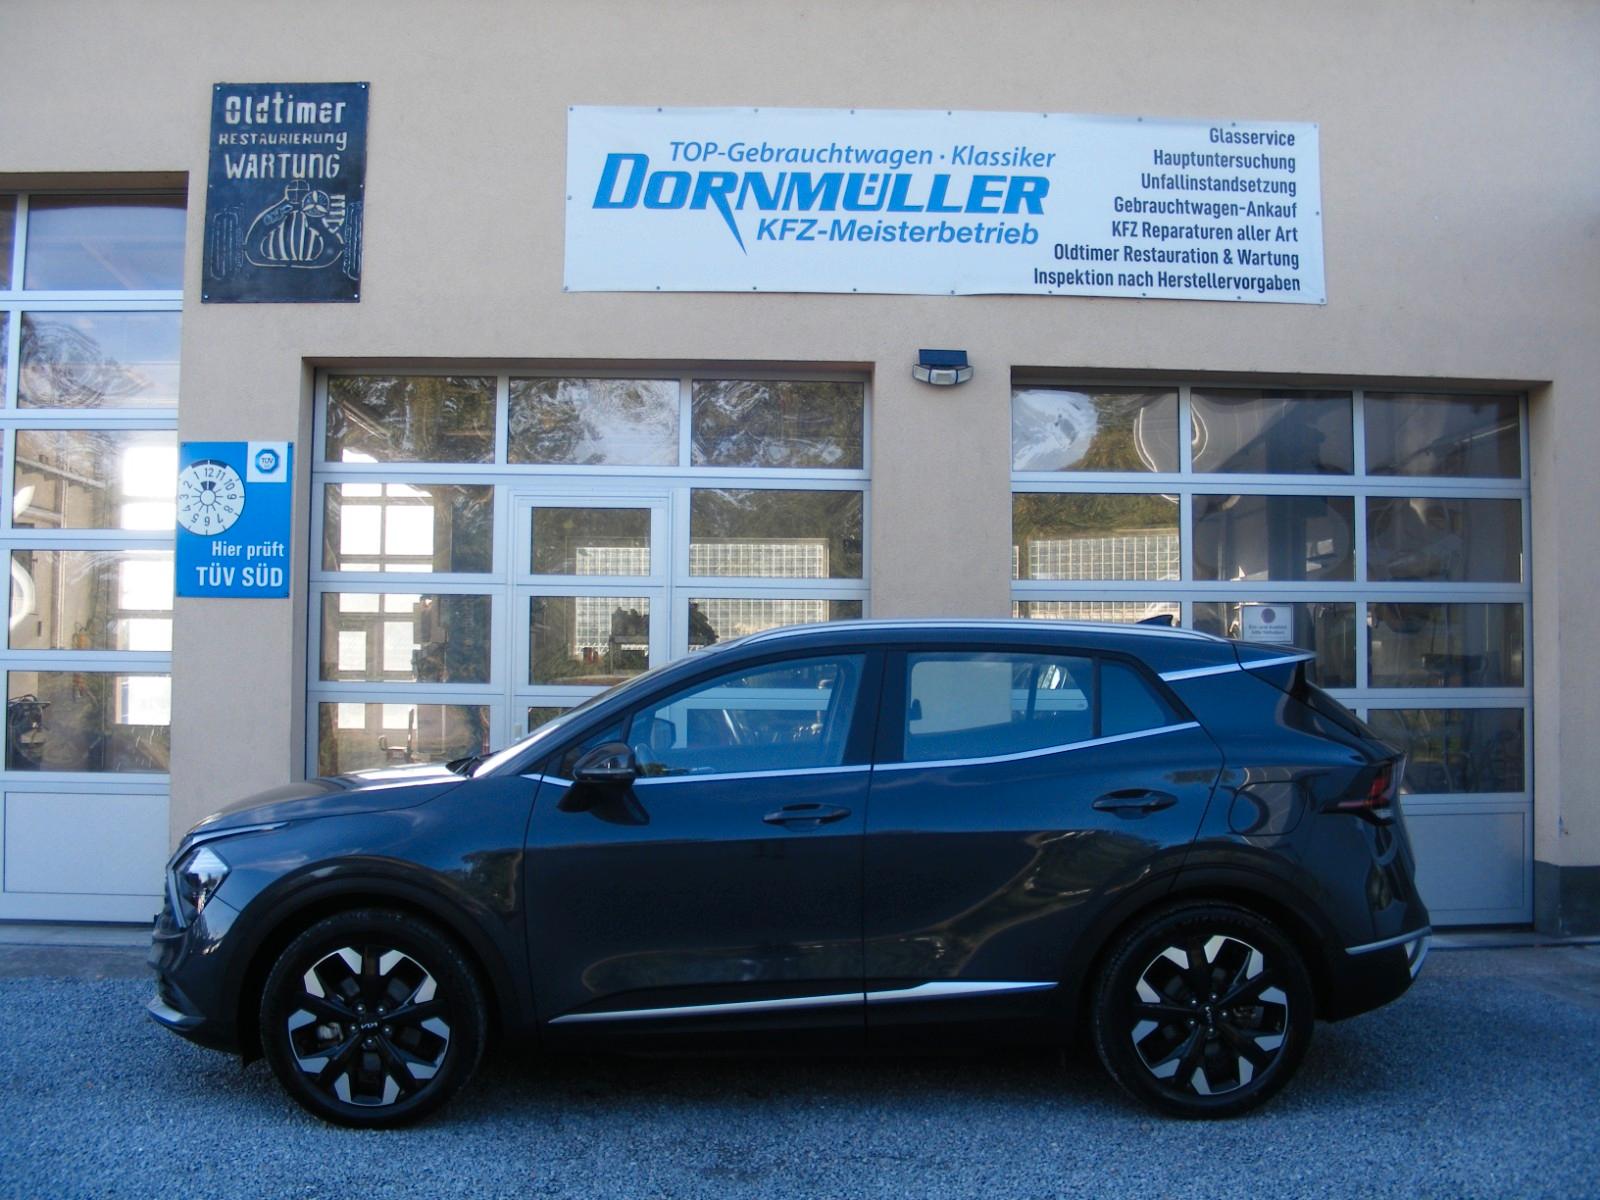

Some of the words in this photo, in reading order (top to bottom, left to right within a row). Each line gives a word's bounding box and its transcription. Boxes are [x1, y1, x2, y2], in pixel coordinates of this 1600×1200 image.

[225, 92, 346, 124] Oldtimer
[1210, 127, 1295, 146] Glasservice
[670, 141, 933, 169] TOP-Gebrauchtwagen
[951, 145, 1056, 168] Klassiker
[1154, 149, 1296, 173] Hauptuntersuchung
[1141, 173, 1296, 197] Unfallinstandsetzung
[1114, 196, 1298, 219] Gebrauchtwagen-Ankauf
[756, 218, 1039, 244] KFZ-Meisterbetrieb
[1112, 220, 1138, 238] KFZ
[1142, 221, 1233, 242] Reparaturen
[1237, 225, 1271, 242] aller
[1275, 225, 1299, 243] Art
[1054, 243, 1120, 261] Oldtimer
[1123, 245, 1219, 265] Restauration
[1223, 248, 1233, 265] &
[1238, 249, 1300, 270] Wartung
[1034, 267, 1114, 288] Inspektion
[1118, 270, 1154, 288] nach
[1158, 271, 1301, 294] Herstellervorgaben
[204, 467, 214, 478] 12
[211, 540, 243, 557] Hier
[246, 541, 285, 561] prüft
[195, 562, 236, 587] TÜV
[241, 562, 283, 587] SÜD
